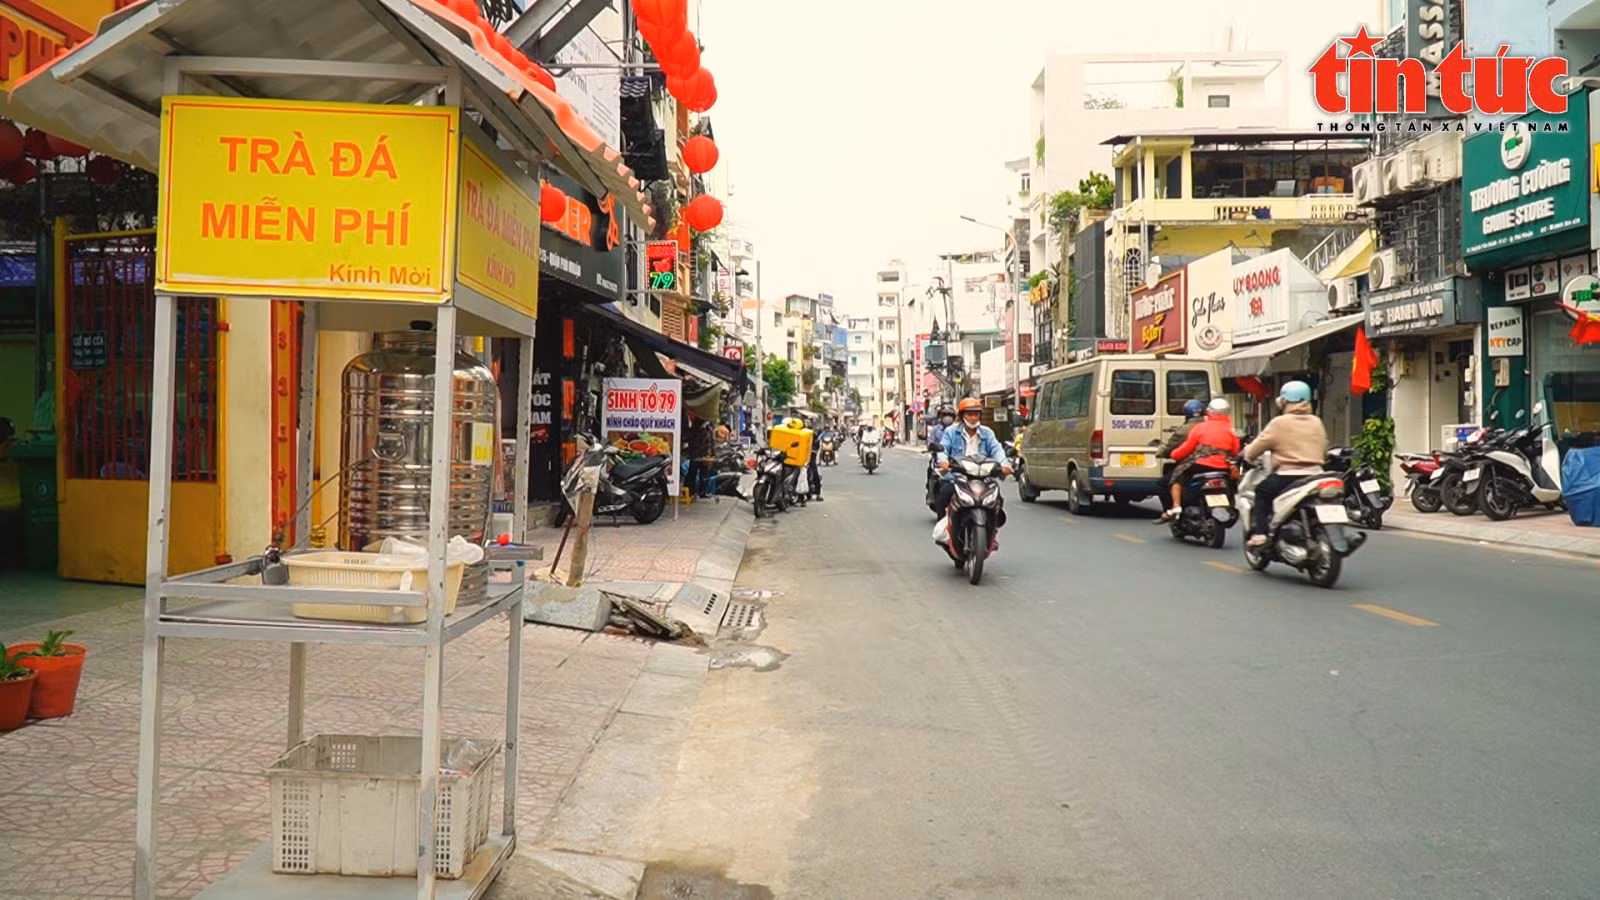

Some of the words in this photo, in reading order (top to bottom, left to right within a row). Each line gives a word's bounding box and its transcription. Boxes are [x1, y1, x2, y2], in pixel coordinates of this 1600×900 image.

[219, 130, 316, 176] TRÀ
[329, 134, 398, 180] ĐÁ
[1470, 176, 1520, 212] TRƯỜNG
[1521, 158, 1571, 195] CƯỜNG
[465, 180, 484, 224] TRÀ
[1483, 209, 1516, 235] GAME
[1515, 197, 1555, 225] STORE
[201, 196, 315, 243] MIỄN
[333, 202, 411, 246] PHÍ
[329, 263, 381, 284] Kính
[389, 265, 431, 286] Mời
[650, 272, 673, 289] 79
[1490, 317, 1520, 331] REPAINT
[1489, 337, 1521, 348] KEYCAP
[607, 390, 637, 410] SINH
[640, 384, 658, 411] TỐ
[660, 392, 676, 411] 79
